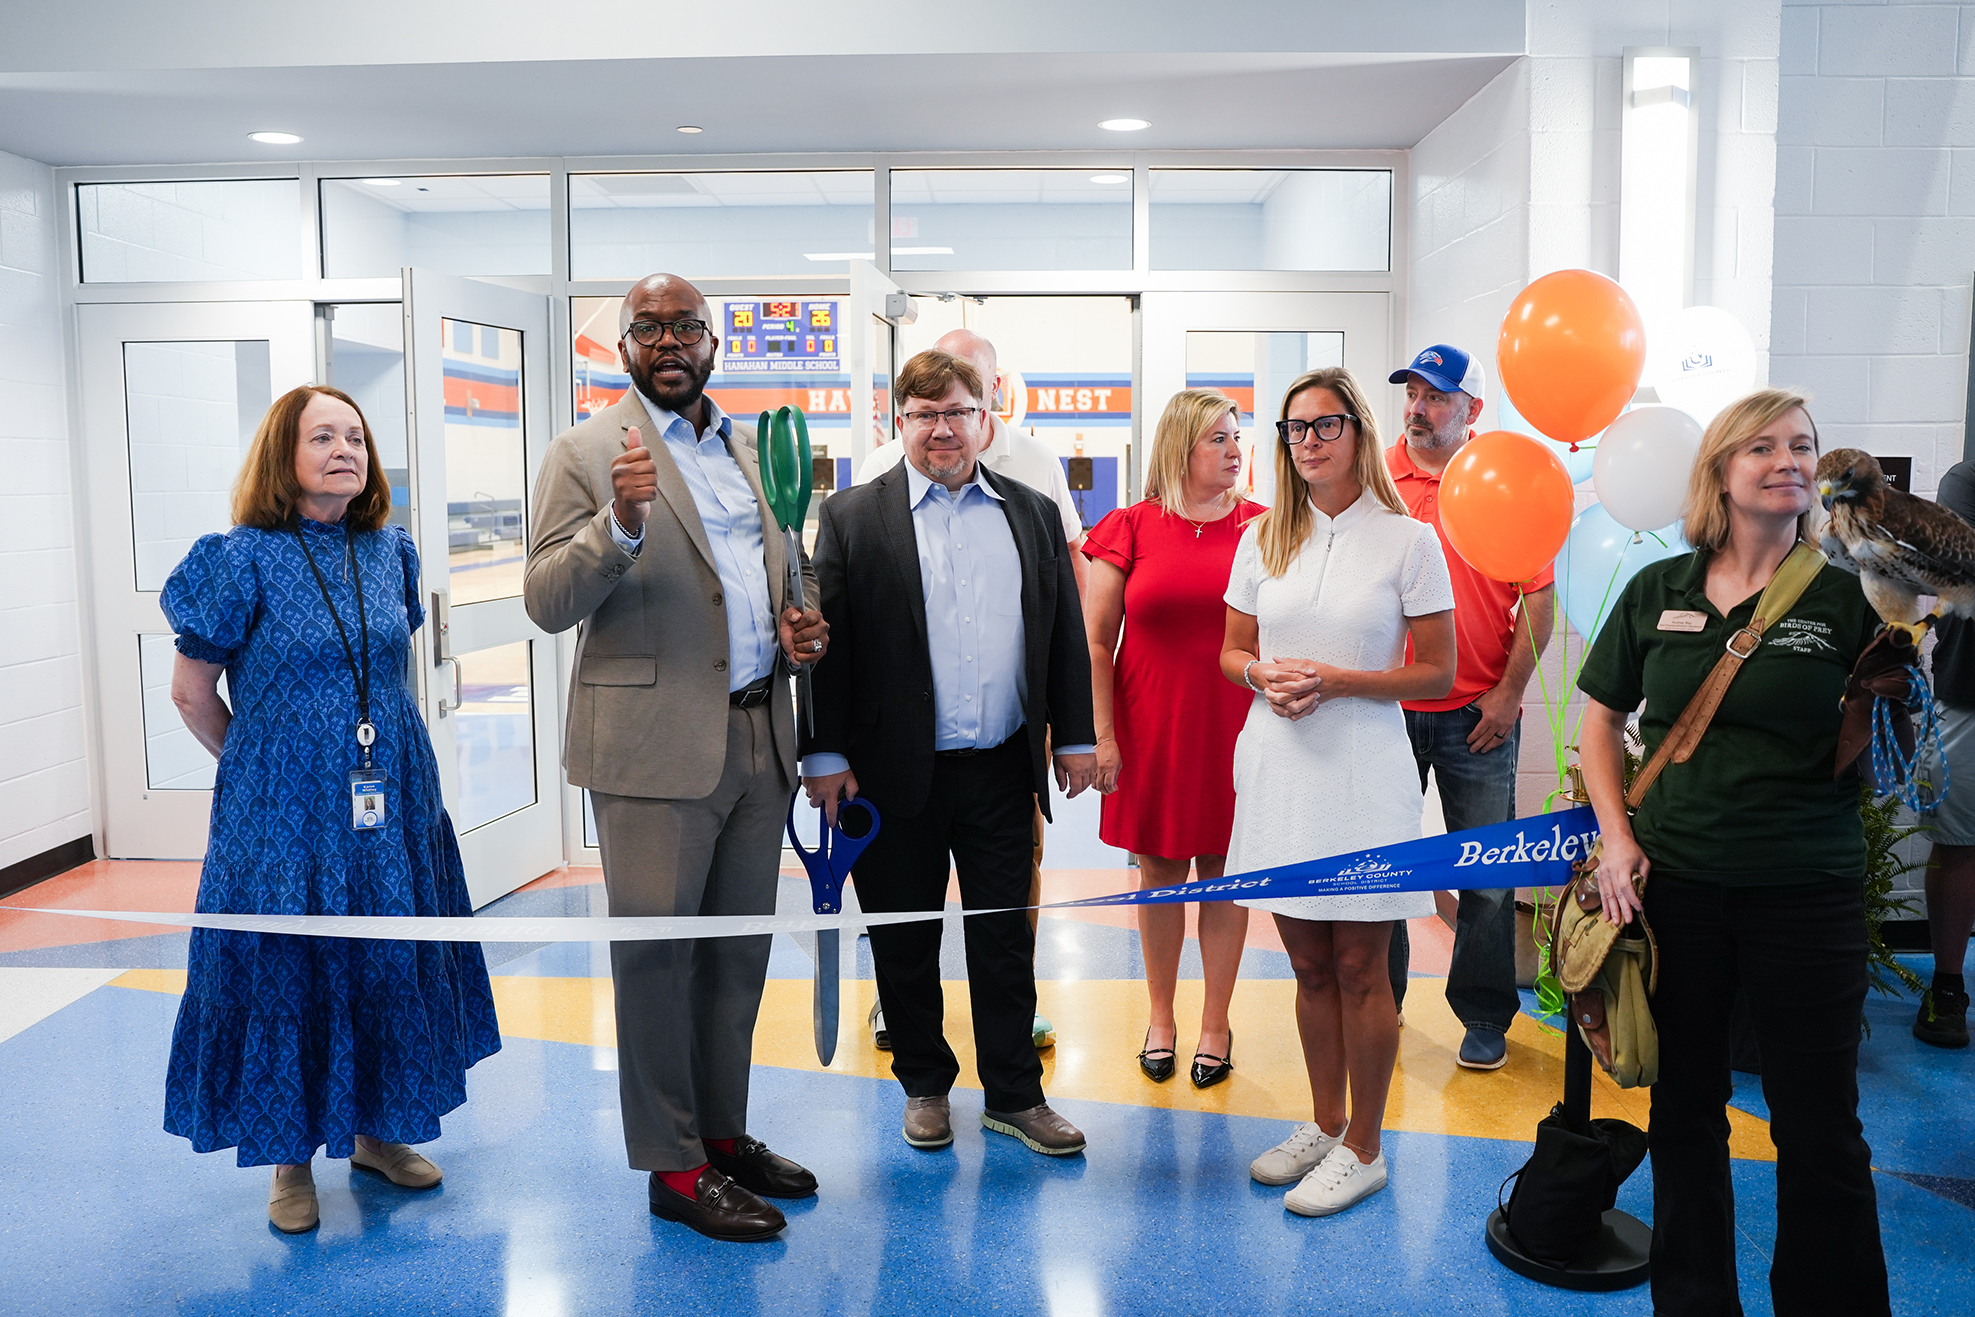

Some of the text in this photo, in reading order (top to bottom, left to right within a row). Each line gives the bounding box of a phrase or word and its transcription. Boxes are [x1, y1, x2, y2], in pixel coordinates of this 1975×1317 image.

[733, 310, 754, 327] 20
[811, 310, 831, 327] 26
[786, 321, 795, 332] 4
[732, 340, 741, 353] 0
[747, 340, 757, 353] 0
[806, 339, 816, 353] 0
[823, 339, 834, 353] 0
[724, 361, 839, 371] HANAHAN MIDDLE SCHOOL
[1037, 388, 1112, 411] NEST
[1813, 626, 1832, 634] PREY
[1793, 645, 1812, 653] STAFF
[1308, 870, 1413, 885] BERKELEY COUNTY
[1147, 876, 1272, 898] District
